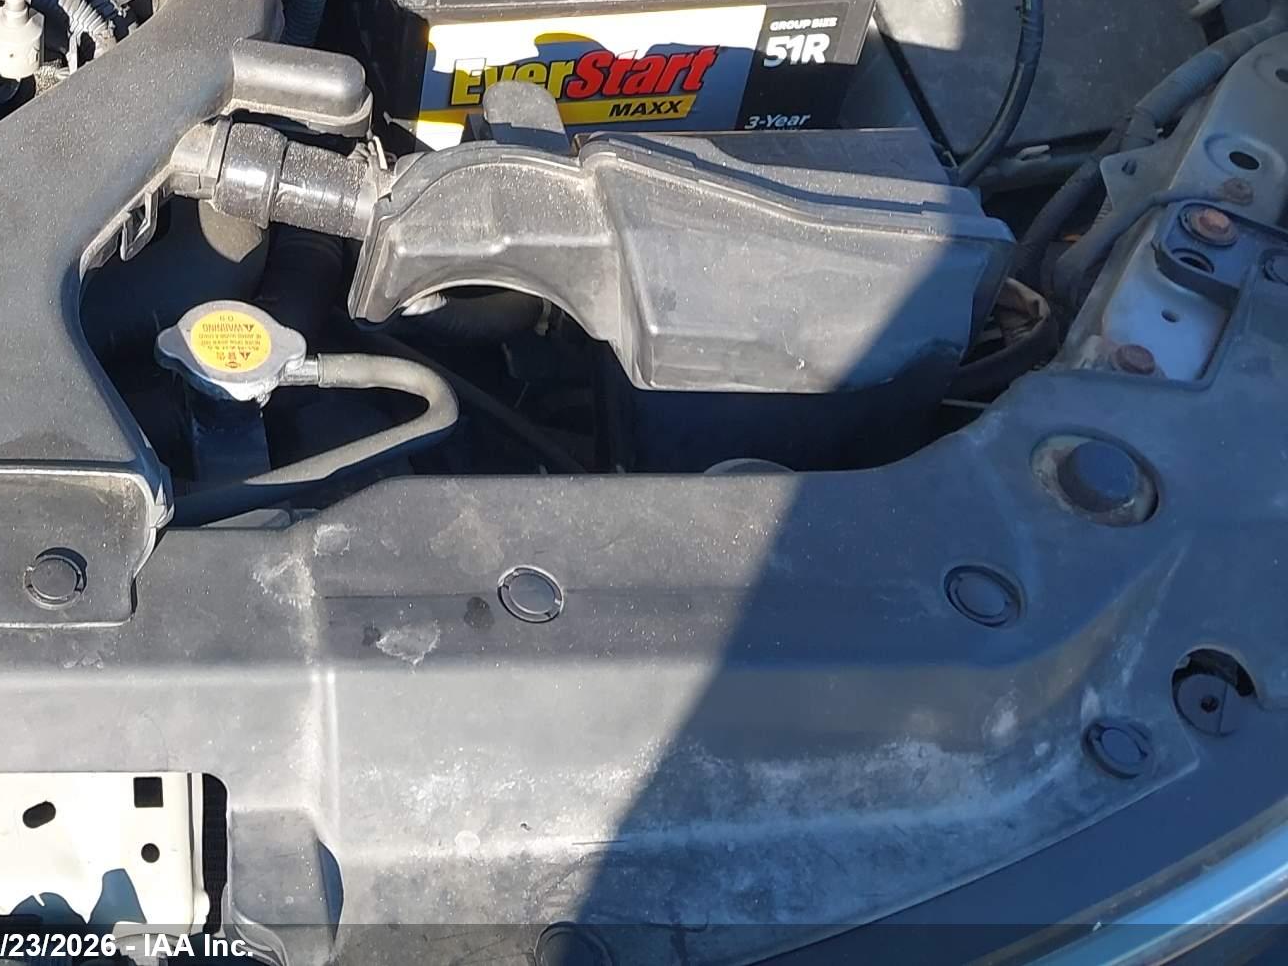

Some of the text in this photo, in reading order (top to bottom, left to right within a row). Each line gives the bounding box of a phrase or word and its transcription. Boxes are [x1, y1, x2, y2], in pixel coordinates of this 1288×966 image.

[769, 19, 811, 31] GROUP
[763, 33, 830, 68] 51R
[450, 44, 721, 107] EverStart
[608, 100, 684, 118] MAXX
[744, 114, 811, 130] 3-Year
